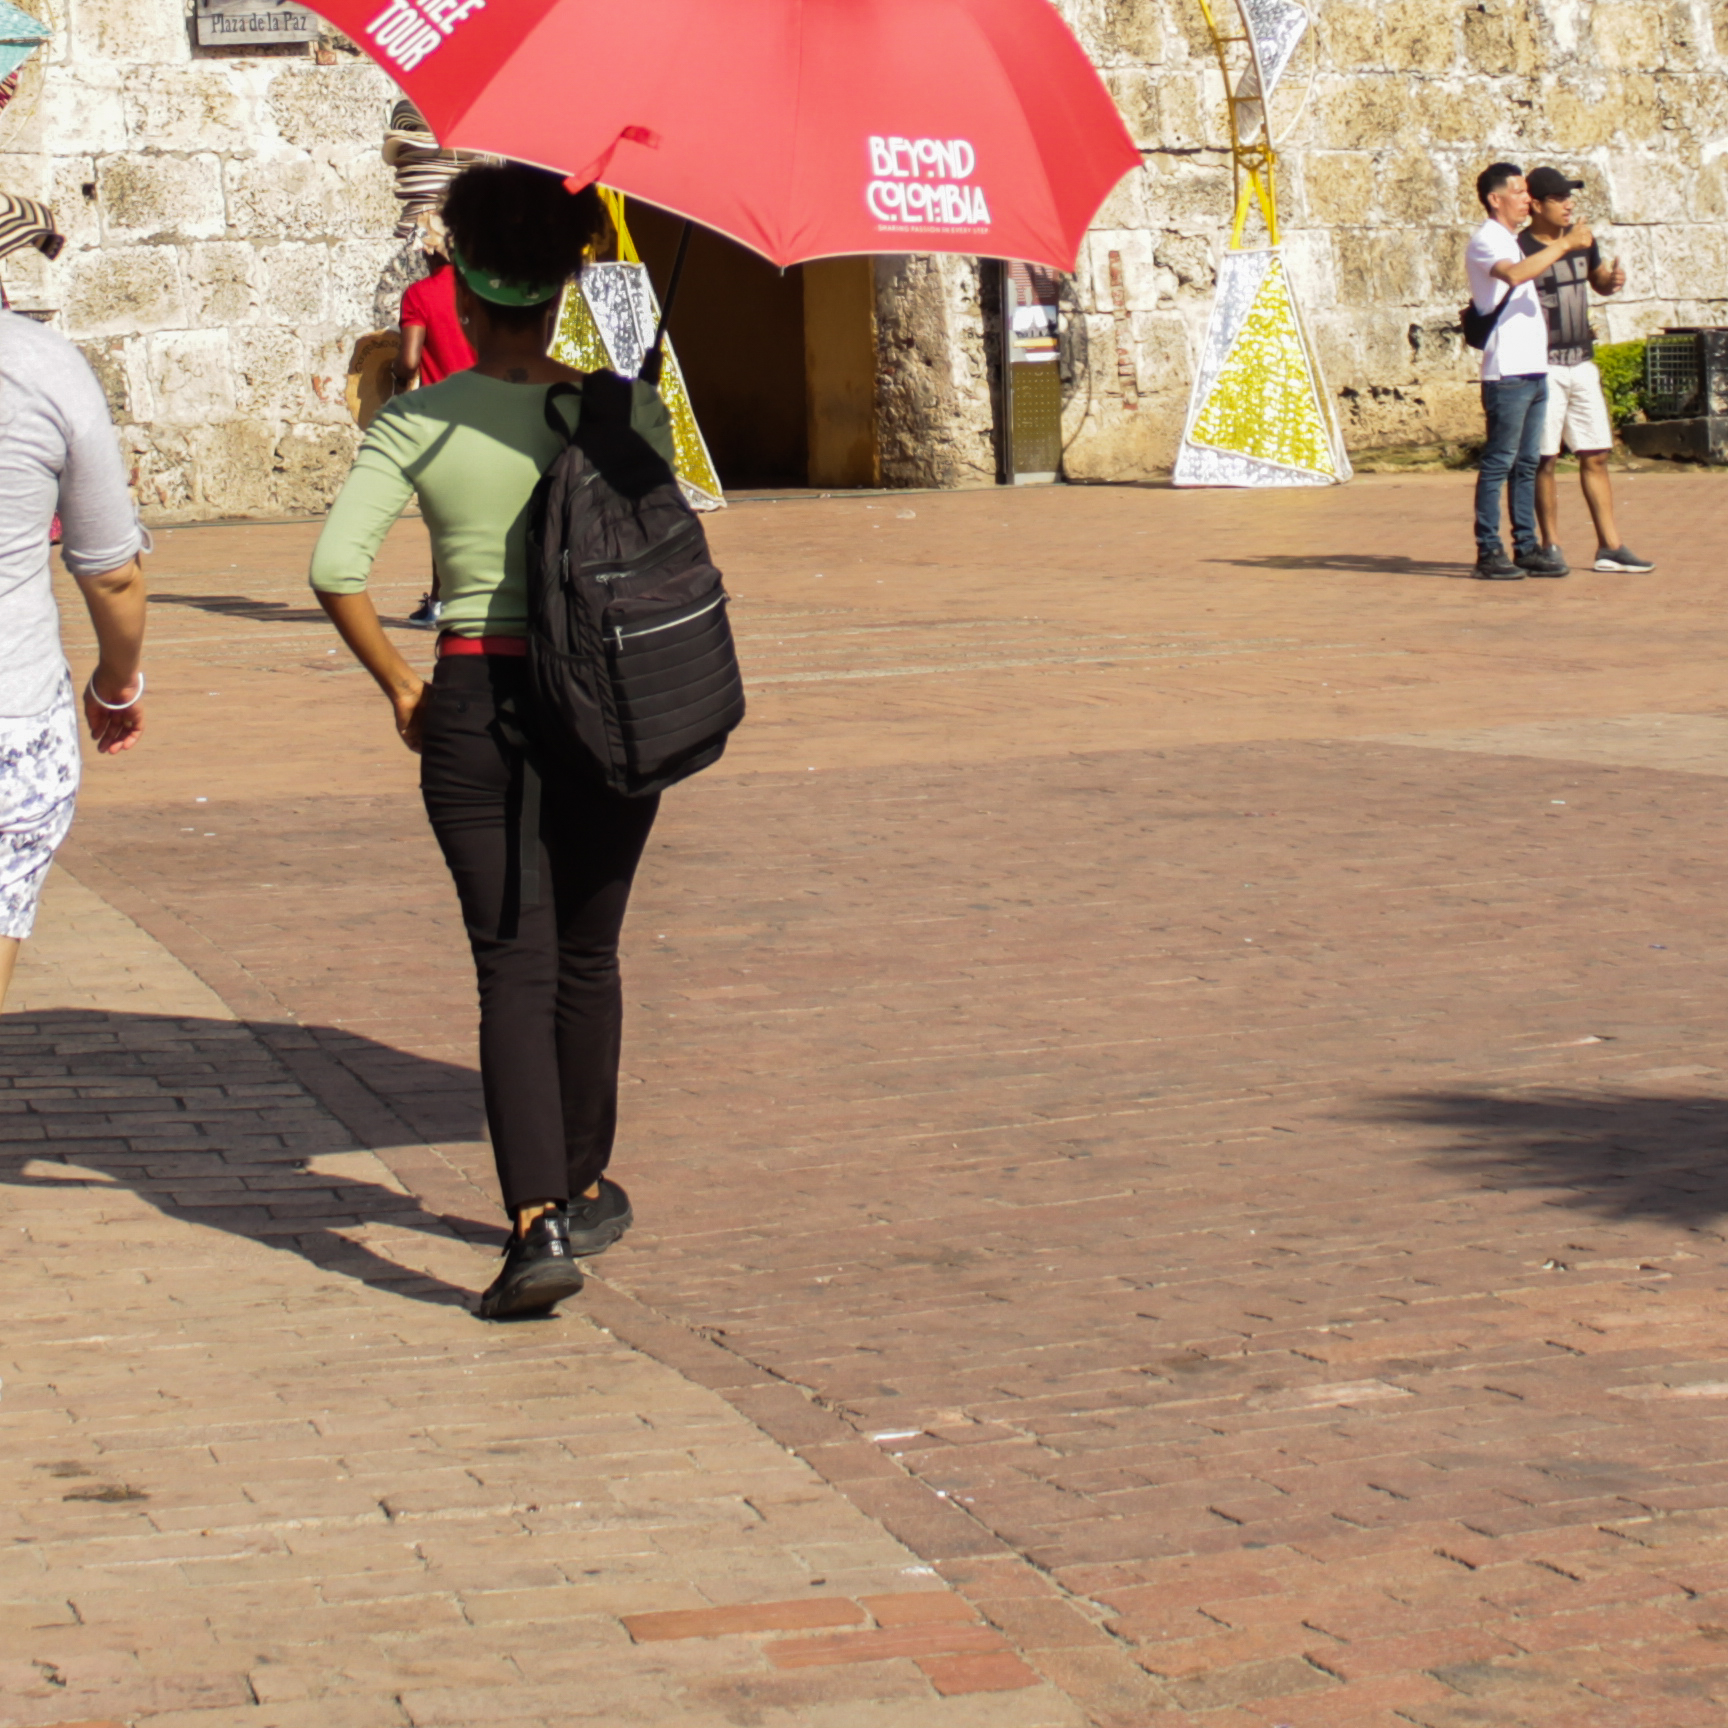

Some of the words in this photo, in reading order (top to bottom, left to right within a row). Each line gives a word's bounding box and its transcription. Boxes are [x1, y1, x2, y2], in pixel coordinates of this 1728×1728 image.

[211, 13, 246, 33] Plaza
[249, 13, 264, 31] de
[267, 12, 279, 31] la
[283, 11, 307, 31] Paz
[869, 136, 975, 179] BEYOND
[867, 180, 991, 224] COLOMBIA
